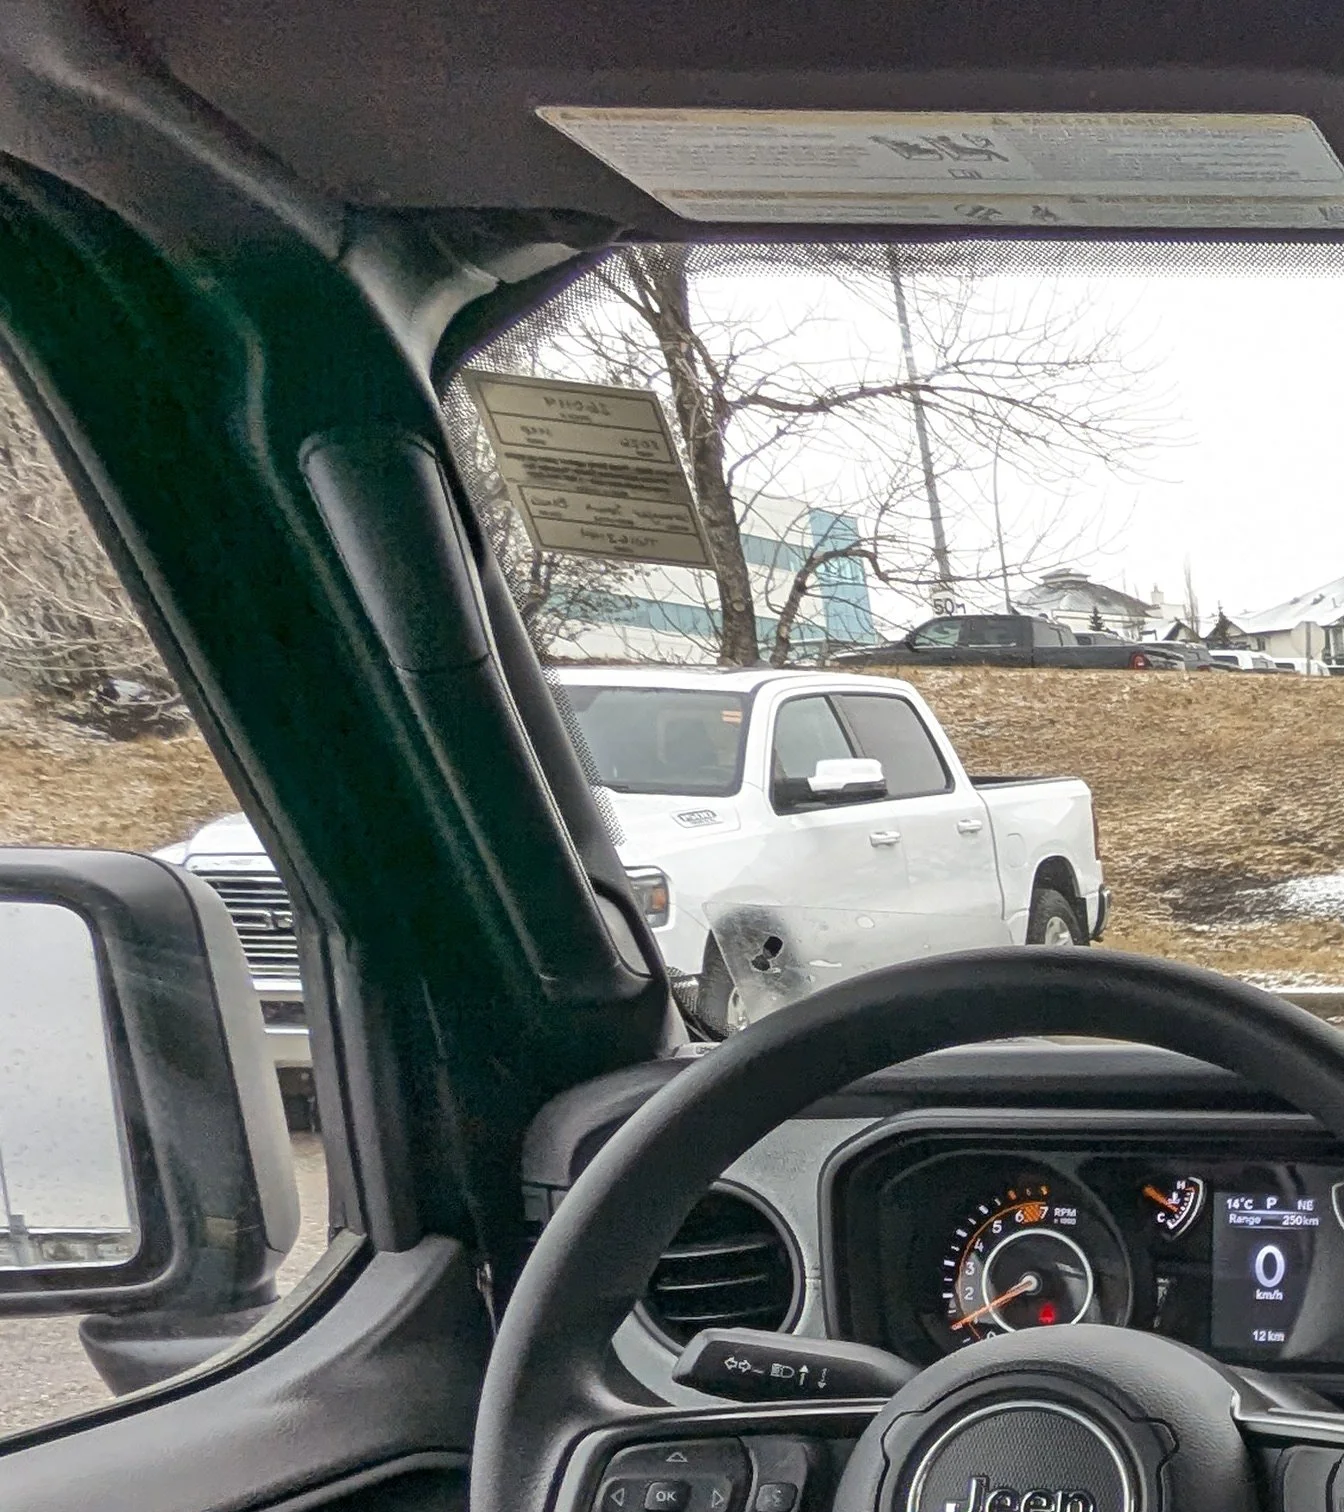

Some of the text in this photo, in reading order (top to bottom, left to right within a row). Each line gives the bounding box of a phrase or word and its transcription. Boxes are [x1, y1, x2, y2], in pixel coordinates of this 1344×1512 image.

[1266, 1197, 1277, 1209] P
[1015, 1209, 1025, 1223] 6
[1039, 1205, 1049, 1219] 7
[1053, 1207, 1077, 1218] RPM
[1229, 1213, 1261, 1226] Range
[991, 1220, 1002, 1234] 5
[973, 1238, 984, 1253] 4
[965, 1262, 975, 1276] 3
[1254, 1244, 1286, 1288] 0
[963, 1286, 974, 1300] 2
[1255, 1289, 1283, 1301] km/h
[1253, 1330, 1285, 1342] 12 km
[655, 1490, 677, 1502] OK
